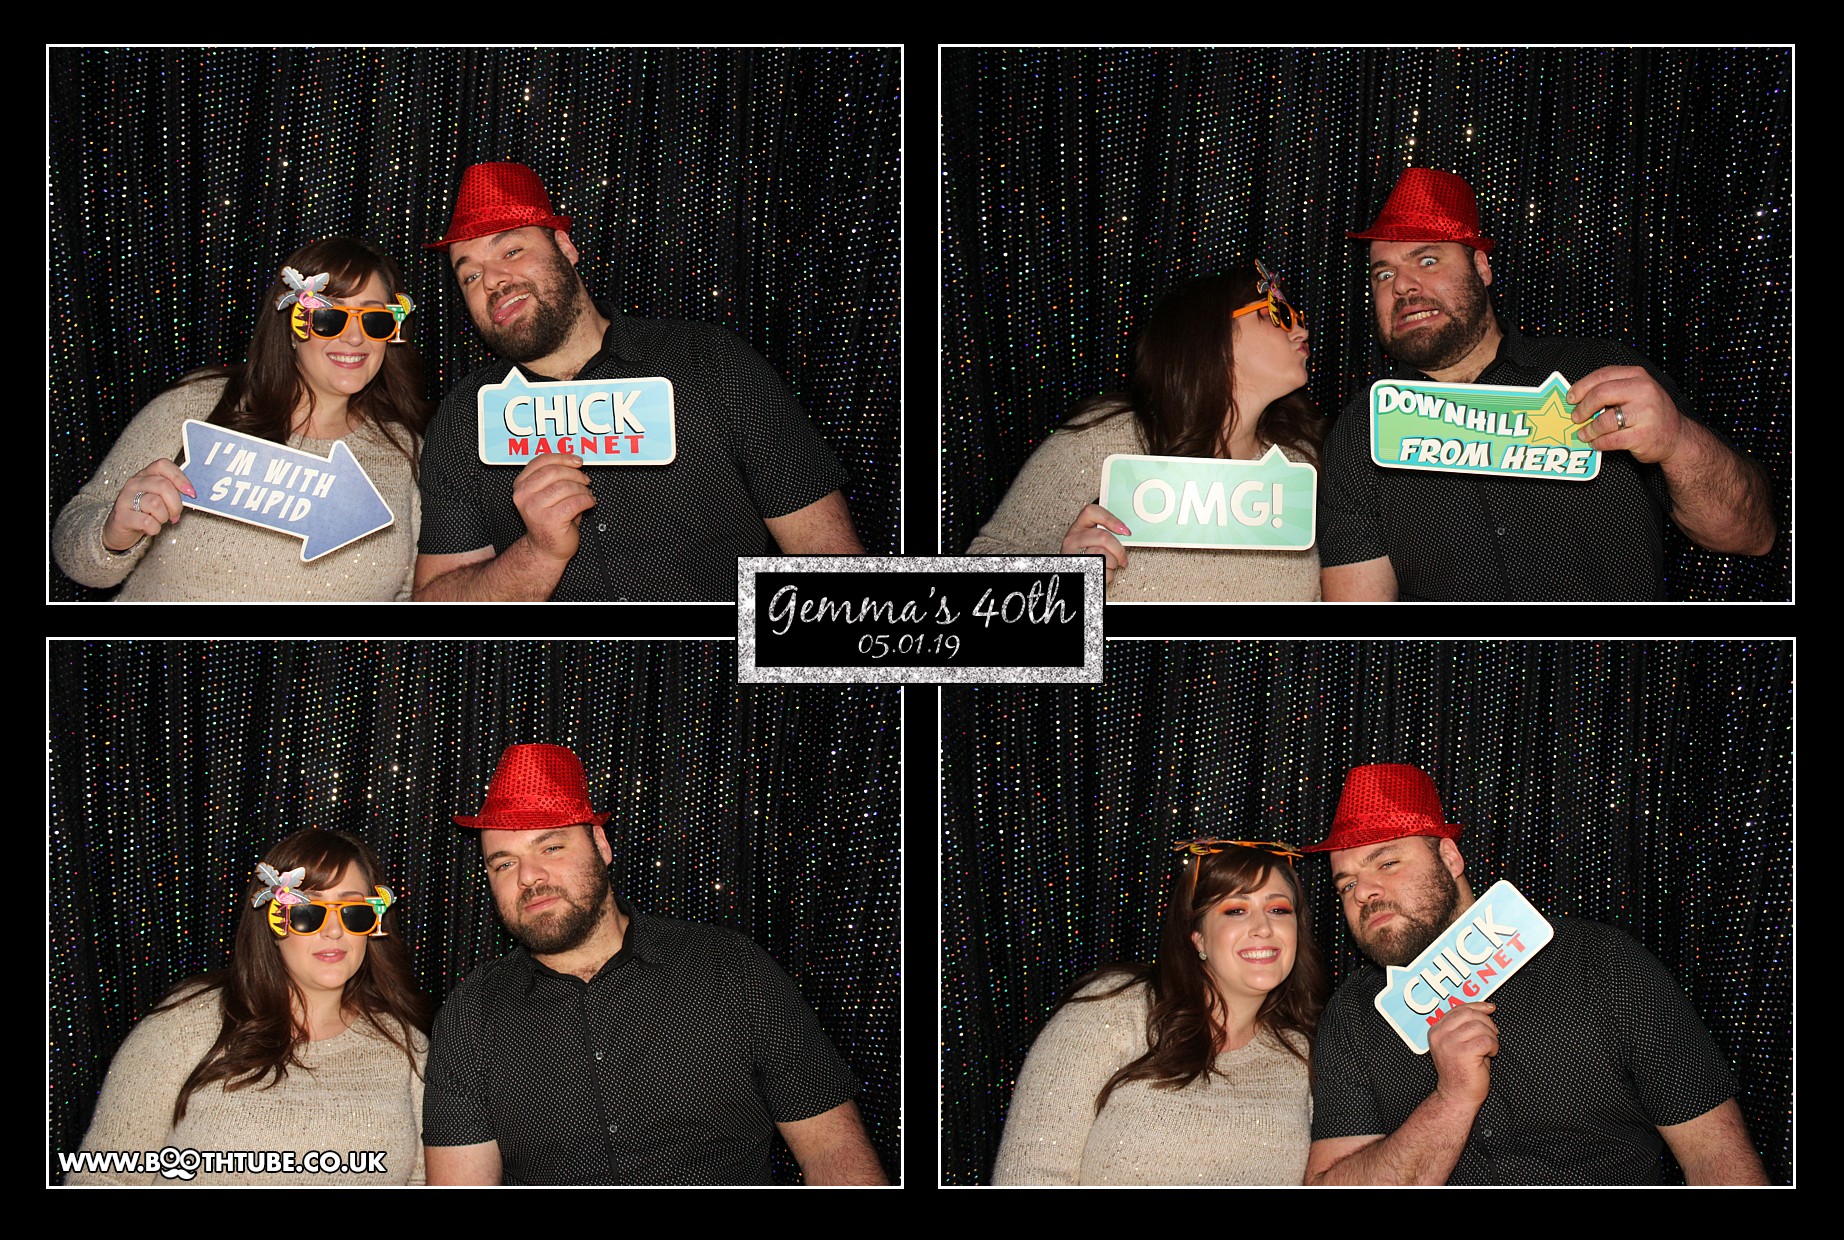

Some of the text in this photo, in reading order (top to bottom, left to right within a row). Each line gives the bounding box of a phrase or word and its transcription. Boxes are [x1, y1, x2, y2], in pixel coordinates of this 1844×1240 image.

[503, 390, 645, 437] CHICK
[1377, 386, 1531, 437] DOWNHILL
[508, 435, 645, 456] MAGNET
[1399, 437, 1593, 475] FROM HERE
[204, 442, 336, 498] I'M WITH
[210, 477, 312, 522] STUPID
[1133, 478, 1283, 528] OMG!
[1403, 903, 1518, 1015] CHICK
